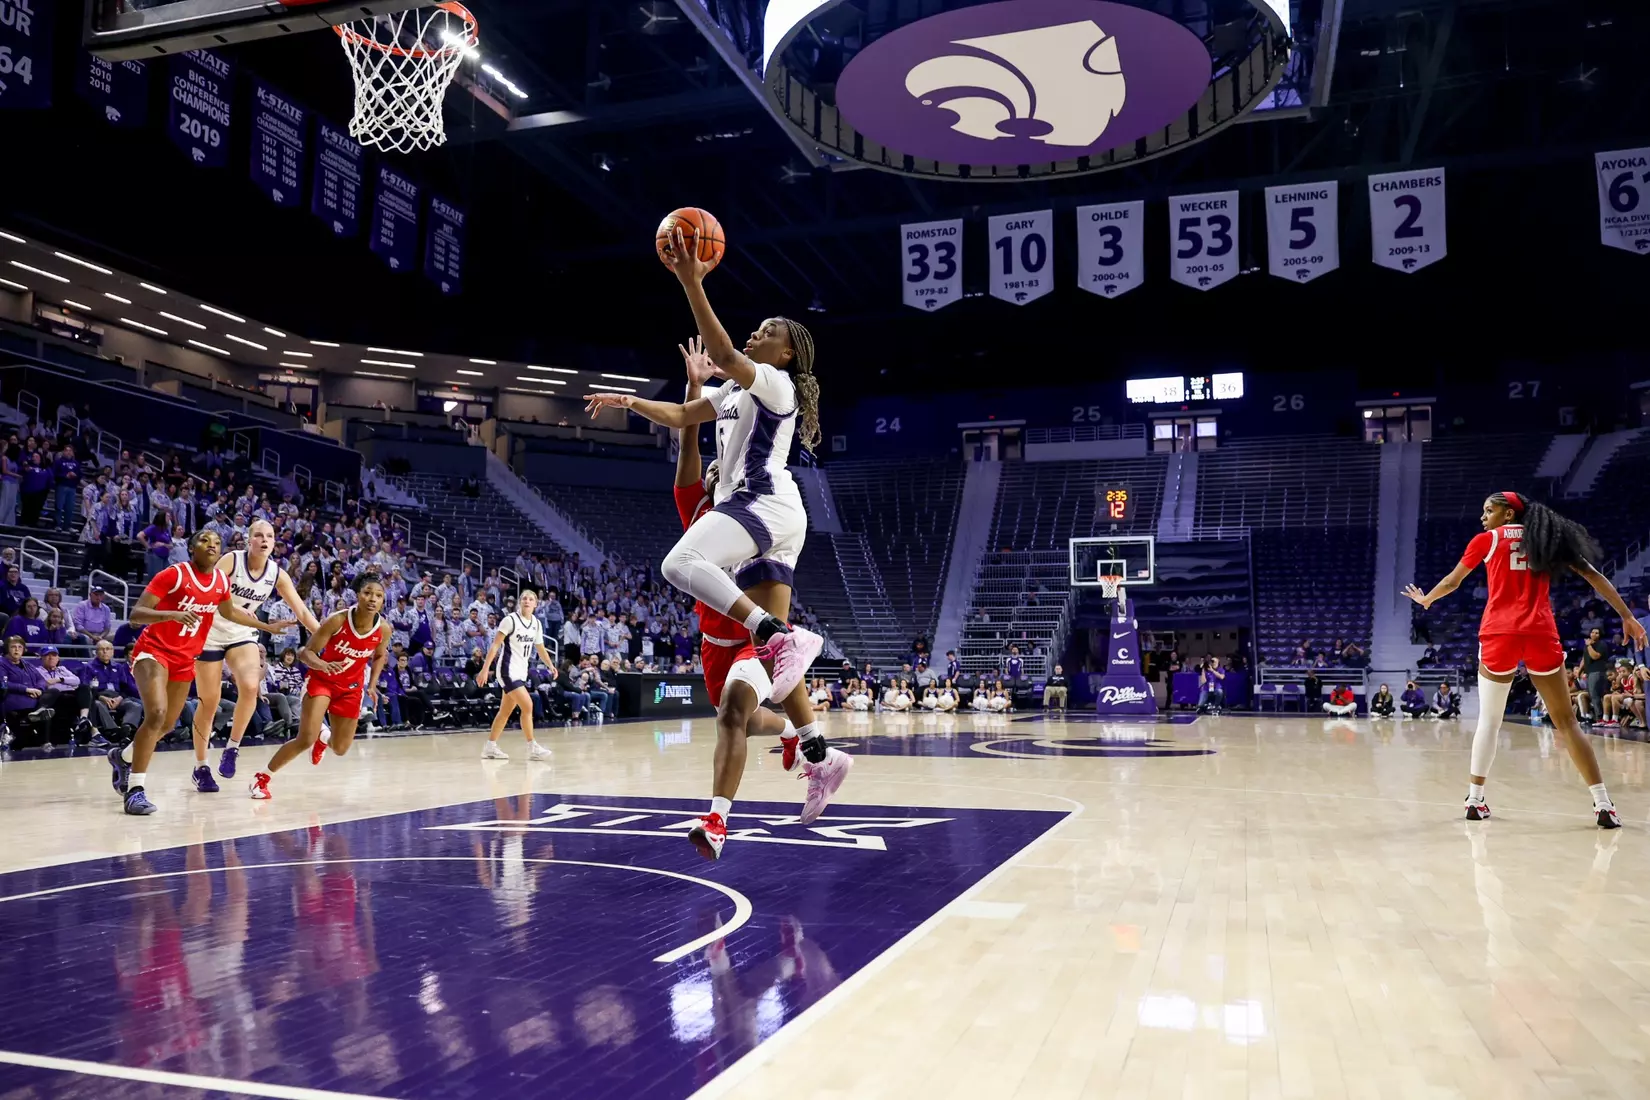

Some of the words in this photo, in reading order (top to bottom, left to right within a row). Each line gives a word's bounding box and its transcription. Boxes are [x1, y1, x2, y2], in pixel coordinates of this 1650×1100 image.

[90, 64, 112, 82] 2010
[121, 60, 141, 75] 2023
[89, 76, 111, 94] 2018
[188, 69, 205, 87] BIG
[207, 81, 218, 94] 12
[174, 75, 230, 113] CONFERENCE
[173, 86, 230, 127] CHAMPIONS
[257, 87, 303, 121] K-STATE
[180, 113, 220, 147] 2019
[321, 125, 362, 157] K-STATE
[1601, 157, 1647, 171] AYOKA
[380, 168, 417, 196] K-STATE
[1372, 176, 1442, 192] CHAMBERS
[1275, 190, 1328, 203] LEHNING
[432, 198, 464, 224] K-STATE
[1180, 200, 1227, 212] WECKER
[1091, 210, 1129, 222] OHLDE
[1394, 195, 1423, 239] 2
[1604, 216, 1629, 224] NCAA
[907, 227, 956, 240] ROMSTAD
[1006, 220, 1035, 231] GARY
[1289, 207, 1316, 250] 5
[1620, 228, 1650, 237] 1/23/2
[1098, 226, 1124, 266] 3
[1177, 215, 1232, 259] 53
[996, 233, 1046, 275] 10
[1389, 245, 1430, 256] 2009-13
[907, 241, 956, 282] 33
[1186, 264, 1224, 273] 2001-05
[1283, 256, 1323, 266] 2005-09
[1005, 280, 1039, 289] 1981-83
[1093, 272, 1129, 282] 2000-04
[915, 287, 948, 296] 1979-82
[1219, 383, 1236, 393] 36
[1508, 380, 1542, 400] 27
[1273, 393, 1305, 412] 26
[1071, 405, 1101, 423] 25
[875, 416, 902, 433] 24
[1106, 490, 1127, 501] 2:35
[1110, 501, 1125, 518] 12
[231, 583, 268, 602] Wildcat
[523, 644, 531, 658] 11
[335, 656, 356, 676] 7
[1100, 686, 1147, 704] Dillons
